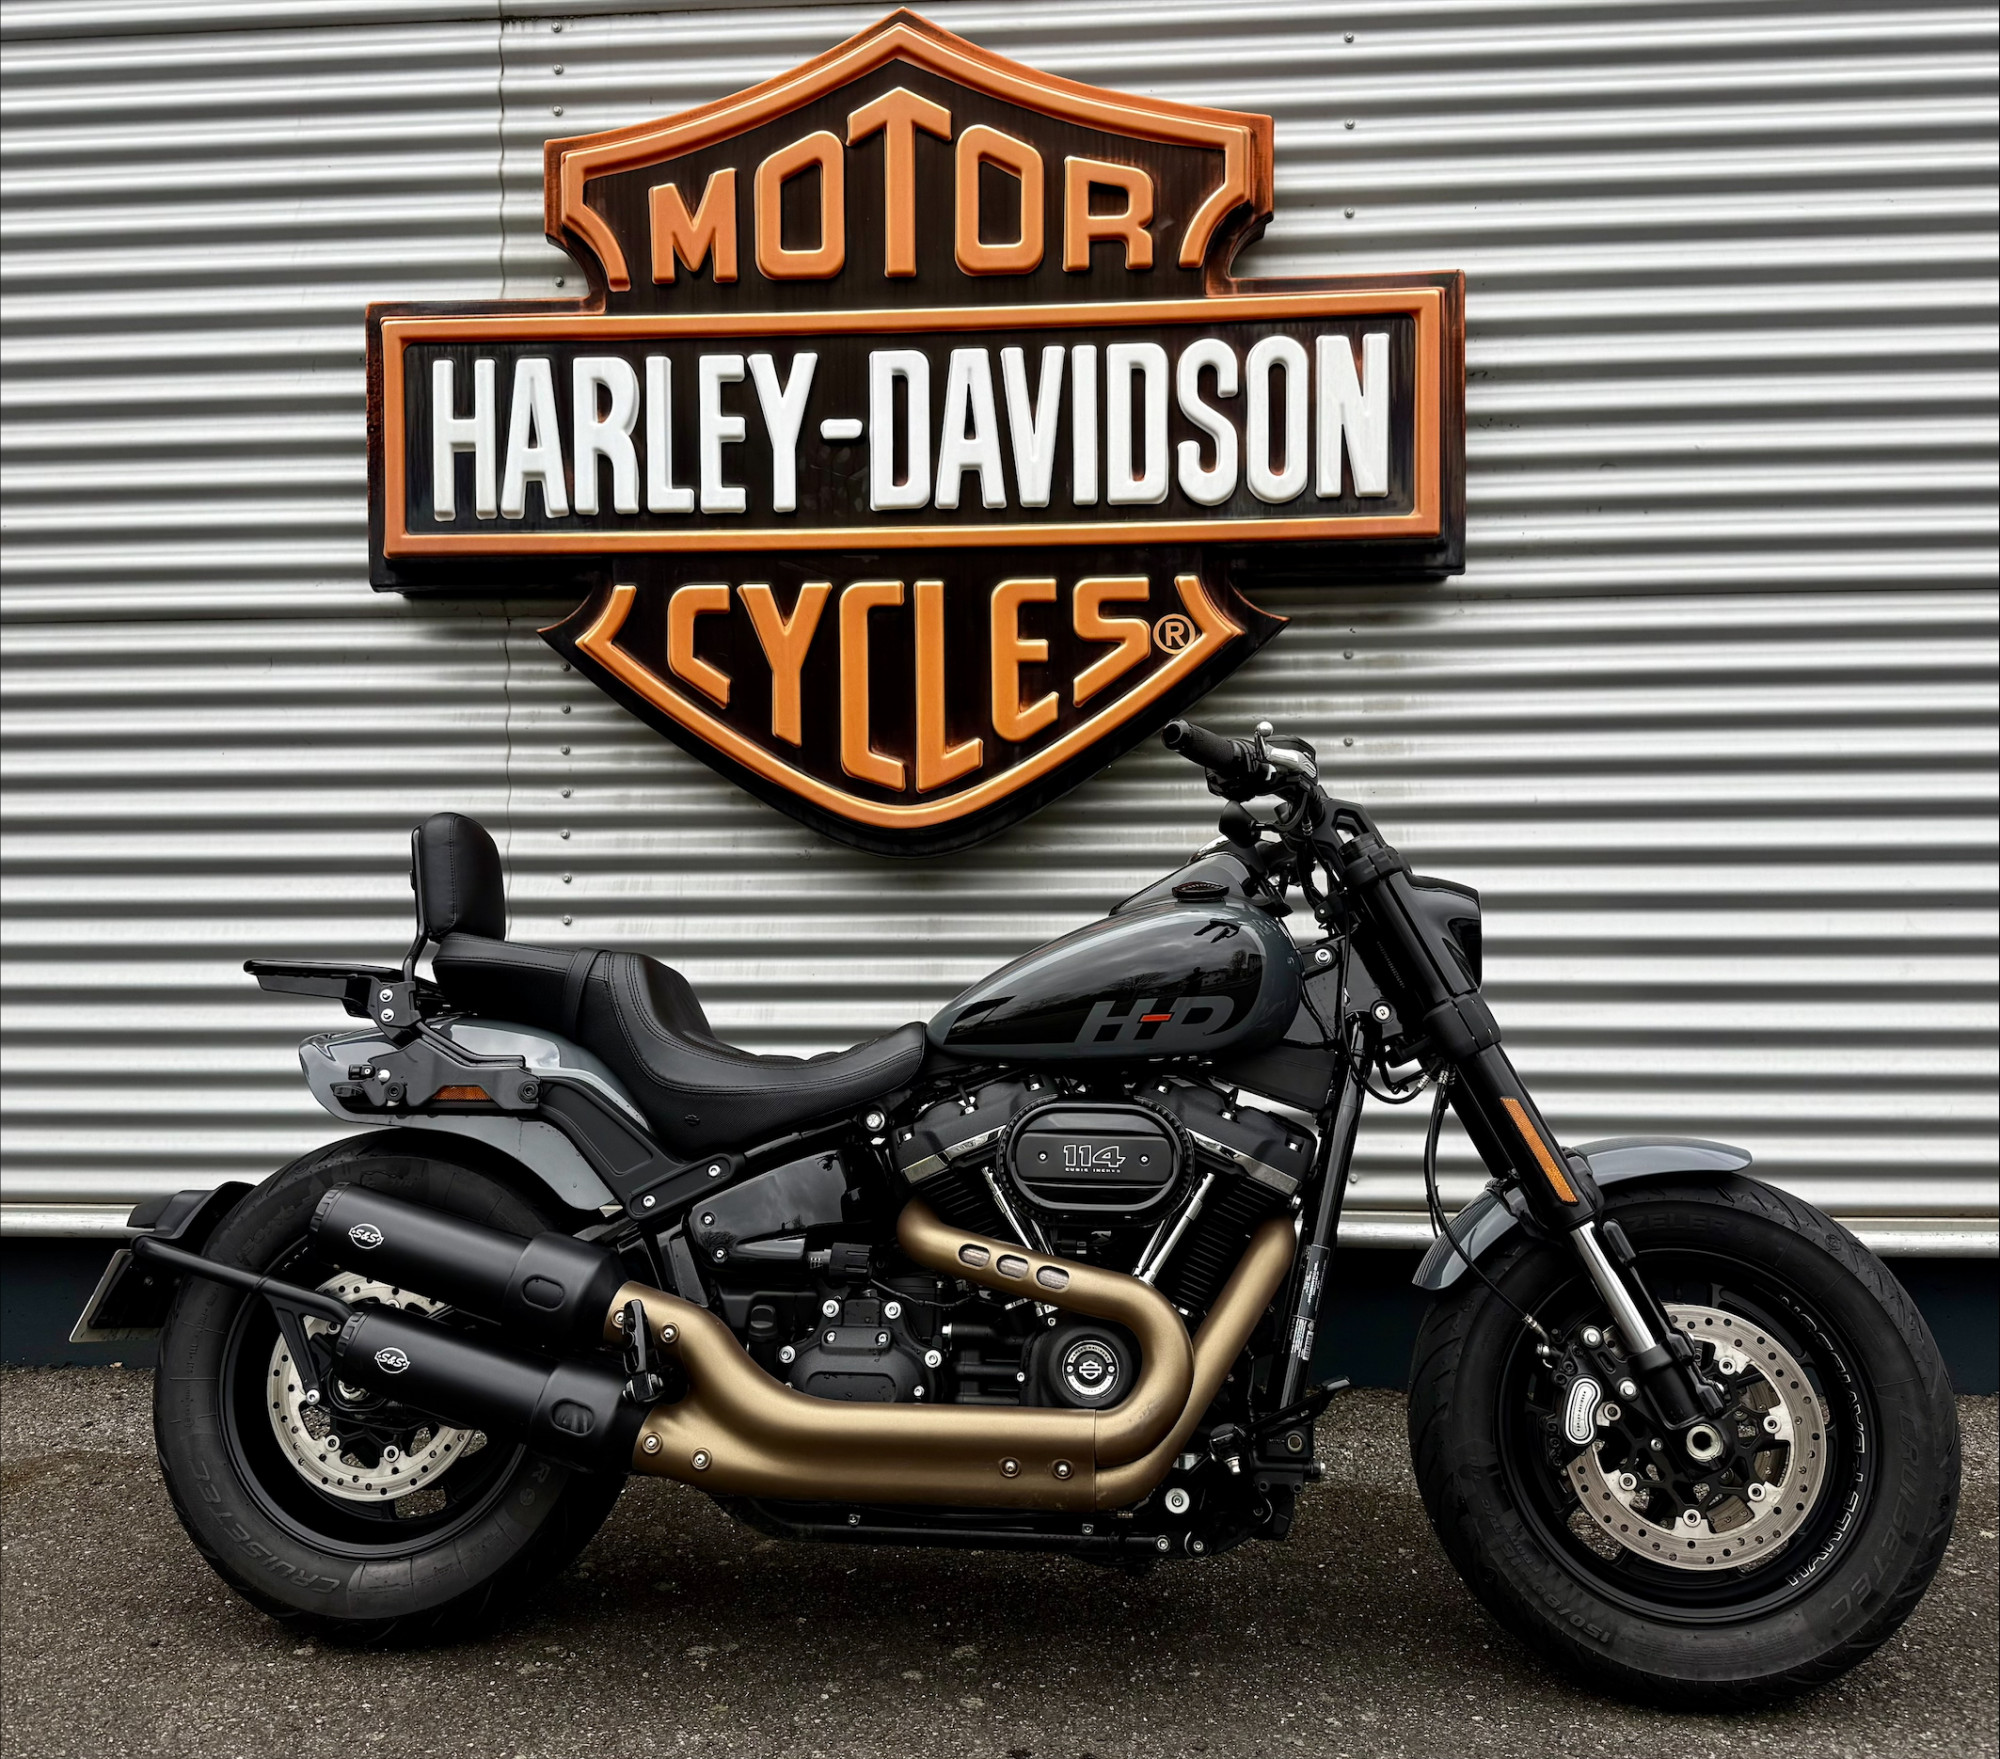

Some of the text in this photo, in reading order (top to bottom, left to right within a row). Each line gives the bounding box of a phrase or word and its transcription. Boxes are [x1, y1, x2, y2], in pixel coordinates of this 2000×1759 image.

[649, 87, 1153, 284] MOTOR
[432, 332, 1391, 521] HARLEY-DAVIDSON
[666, 575, 1151, 793] CYCLES
[1074, 995, 1235, 1043] H-D
[1063, 1145, 1126, 1168] 114
[1621, 1211, 1730, 1235] ZELER
[190, 1460, 341, 1594] CRUISETEC
